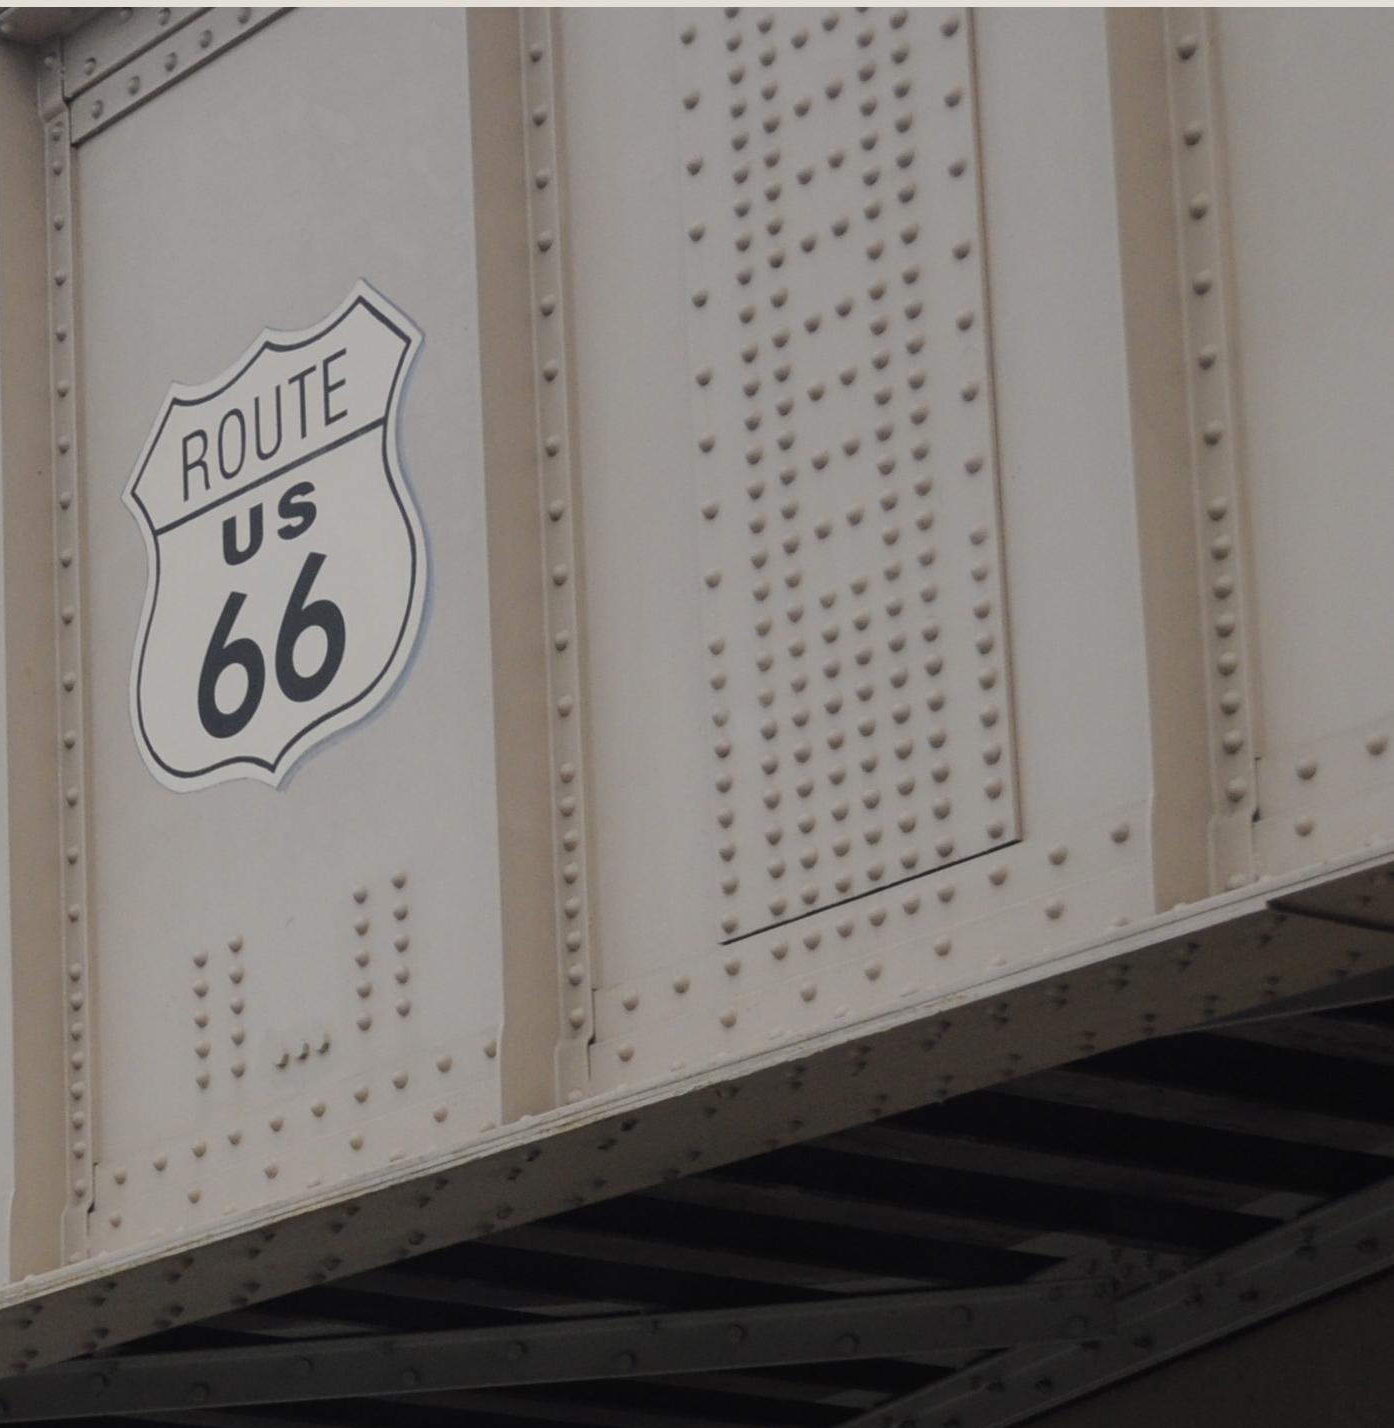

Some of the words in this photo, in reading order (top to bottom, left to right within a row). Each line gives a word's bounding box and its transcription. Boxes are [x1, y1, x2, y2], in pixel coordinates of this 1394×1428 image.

[181, 346, 349, 502] ROUTE
[222, 481, 318, 566] US
[197, 551, 347, 739] 66
